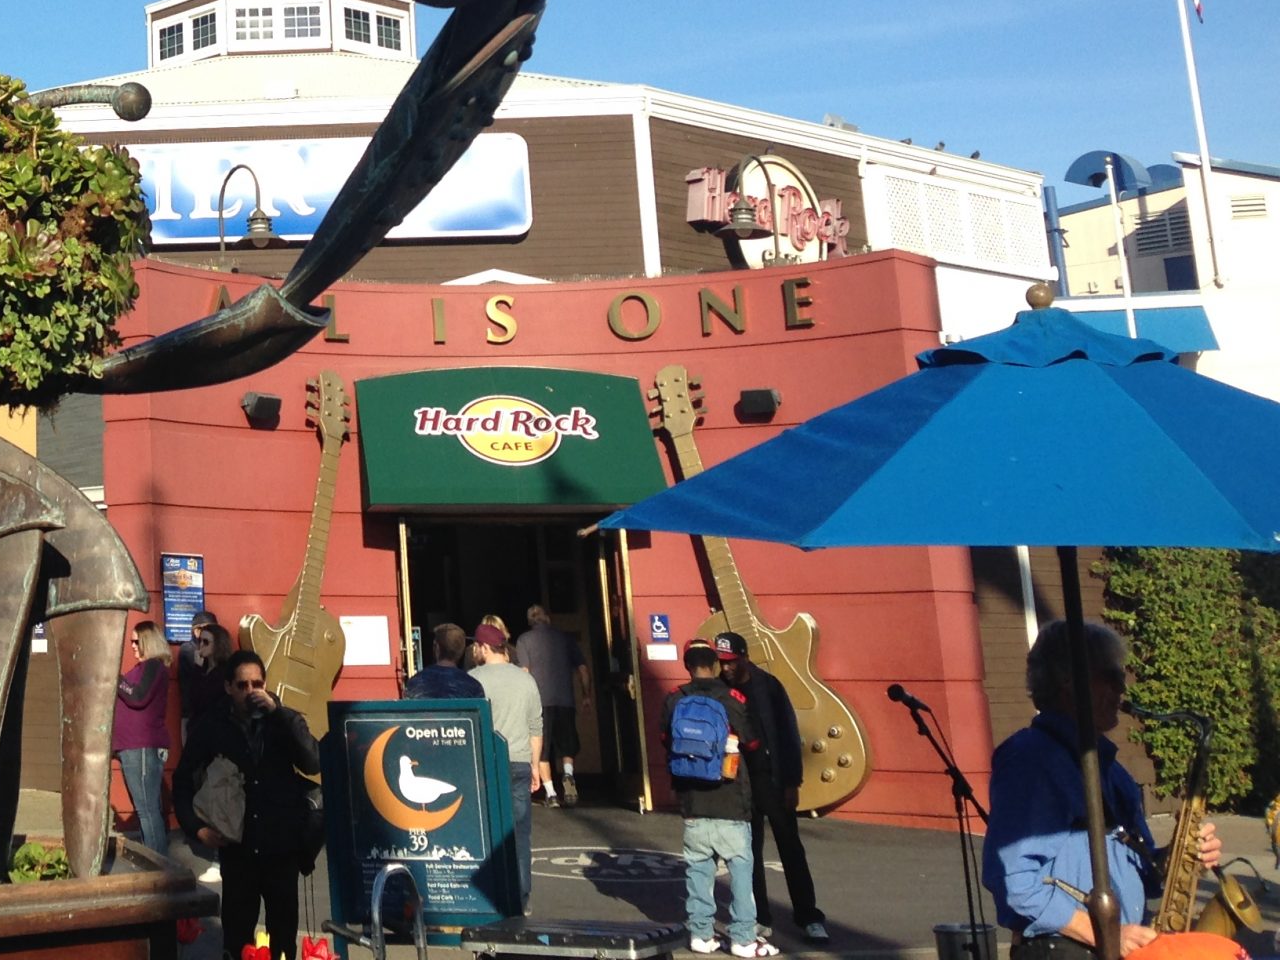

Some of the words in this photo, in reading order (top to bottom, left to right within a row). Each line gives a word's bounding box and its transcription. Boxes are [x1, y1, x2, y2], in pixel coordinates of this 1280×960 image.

[607, 277, 815, 342] ONE
[417, 409, 501, 432] Hard
[510, 409, 593, 438] Rock
[490, 442, 534, 451] CAFE
[405, 727, 439, 740] Open
[441, 727, 466, 738] Late
[409, 836, 428, 851] 39
